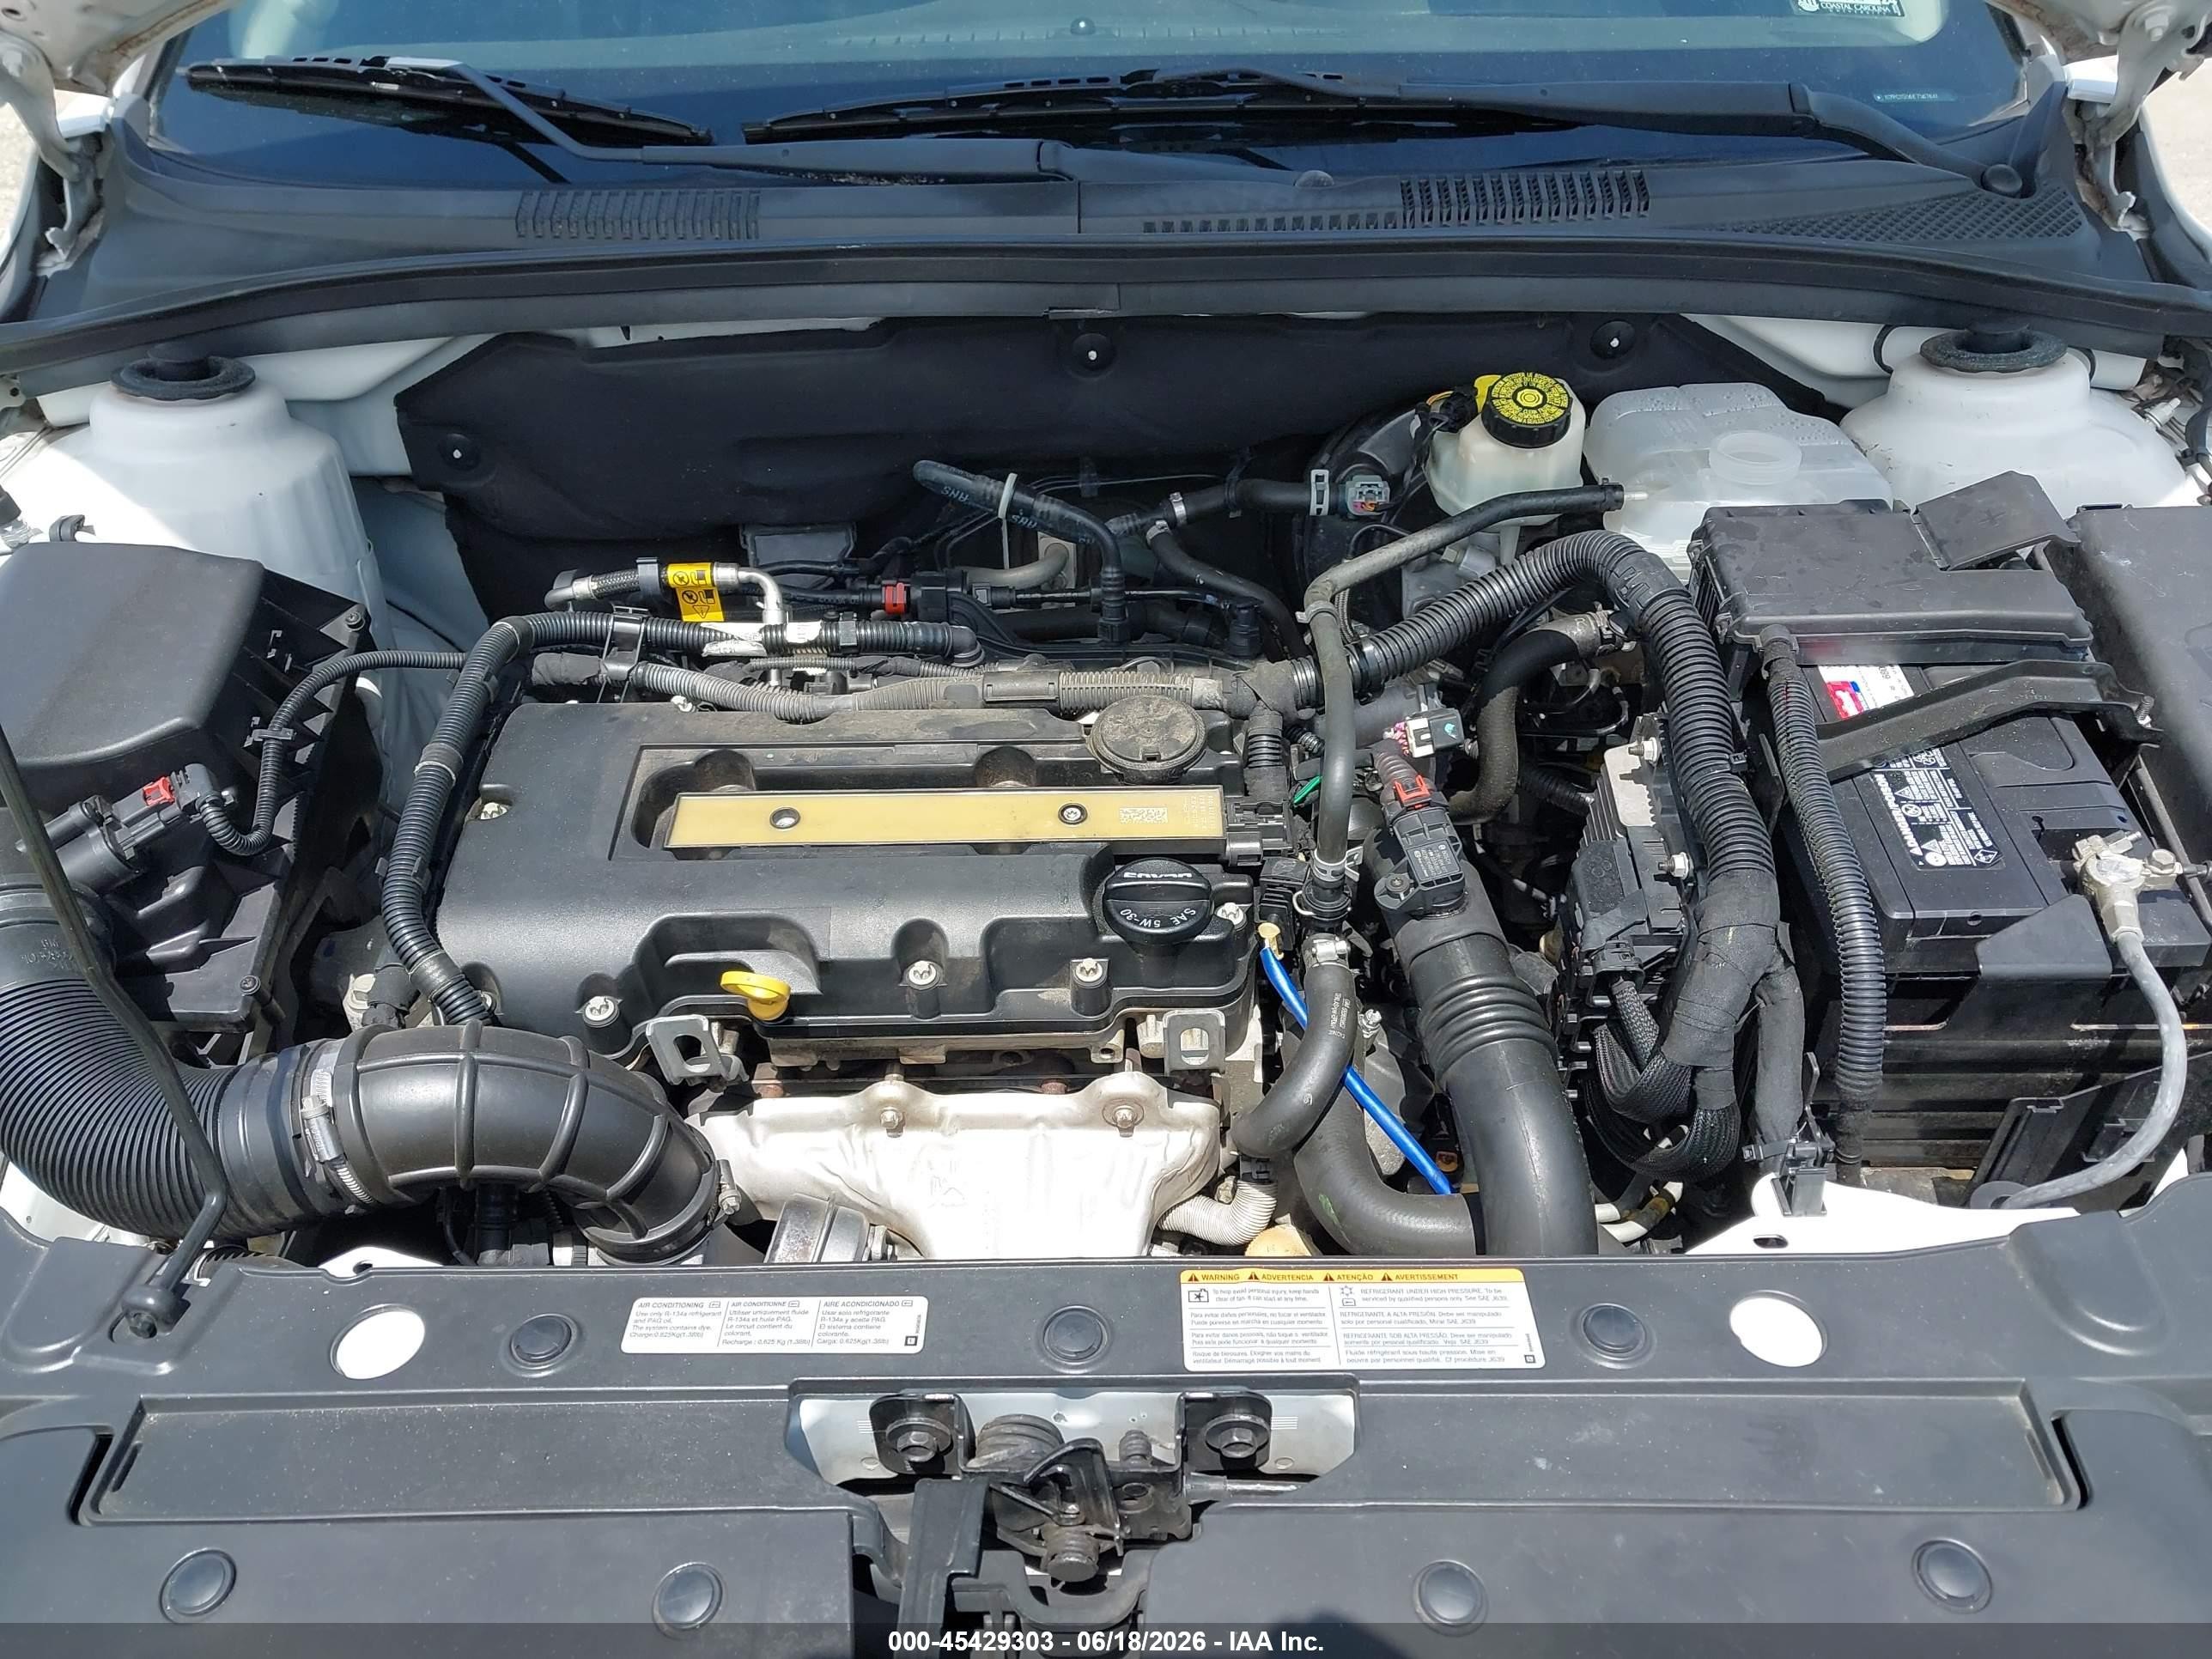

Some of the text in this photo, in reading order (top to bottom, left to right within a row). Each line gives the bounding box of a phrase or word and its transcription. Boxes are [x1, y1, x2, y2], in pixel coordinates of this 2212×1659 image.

[1854, 4, 1891, 13] CAROLINA
[1120, 907, 1196, 928] SAE 5W-30
[1336, 1273, 1374, 1282] ATENÇÃO
